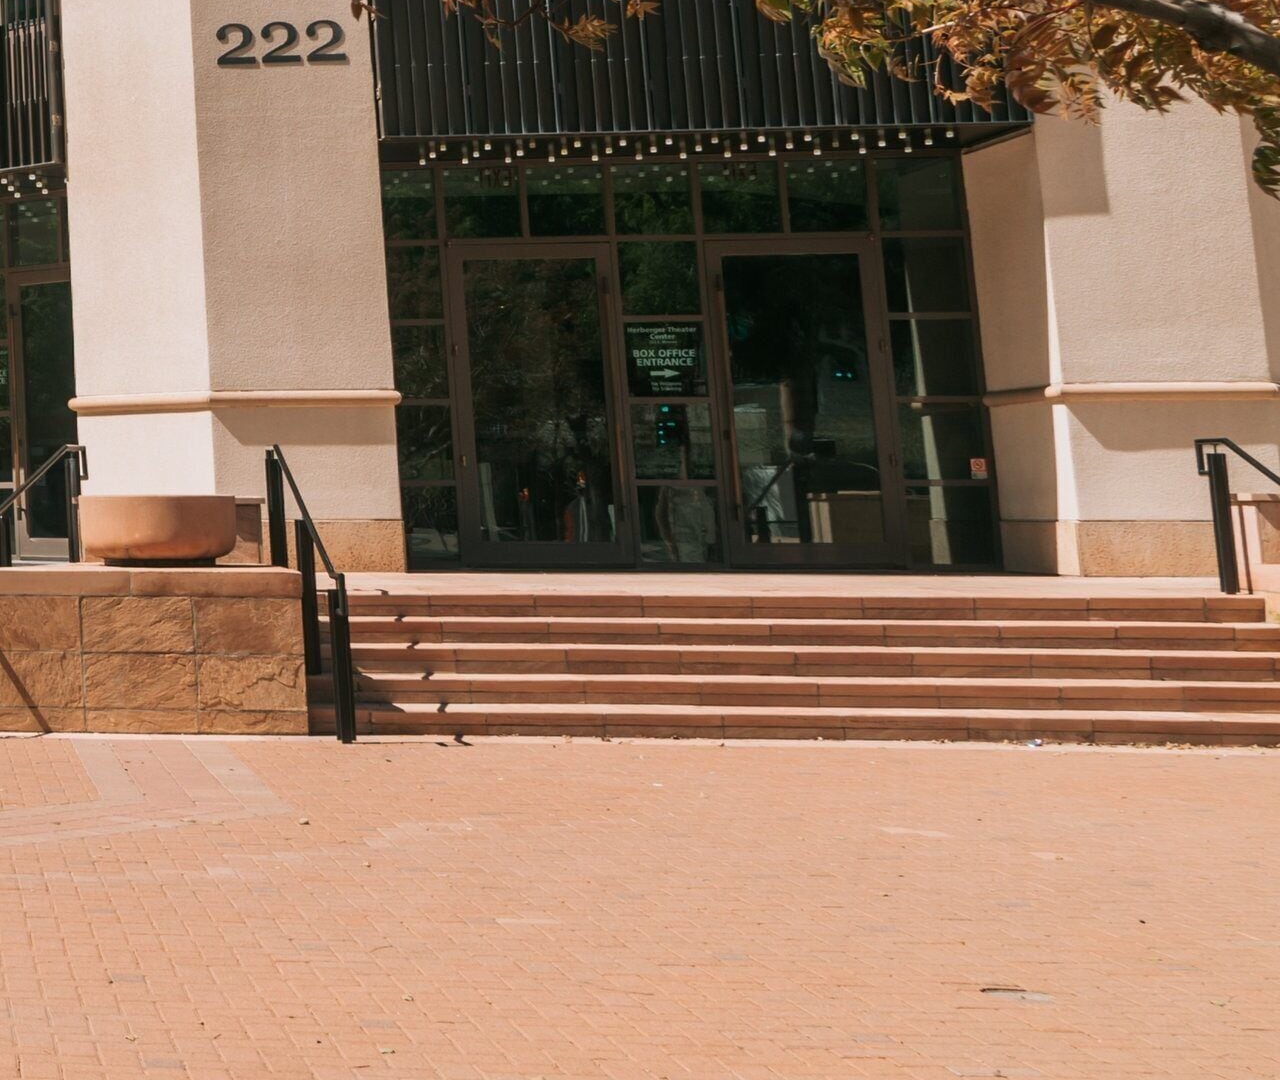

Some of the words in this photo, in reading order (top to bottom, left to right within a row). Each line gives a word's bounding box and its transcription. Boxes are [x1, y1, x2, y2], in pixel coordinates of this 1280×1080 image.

[216, 20, 347, 65] 222
[632, 349, 656, 358] BOX
[658, 348, 697, 358] OFFICE
[636, 358, 694, 367] ENTRANCE
